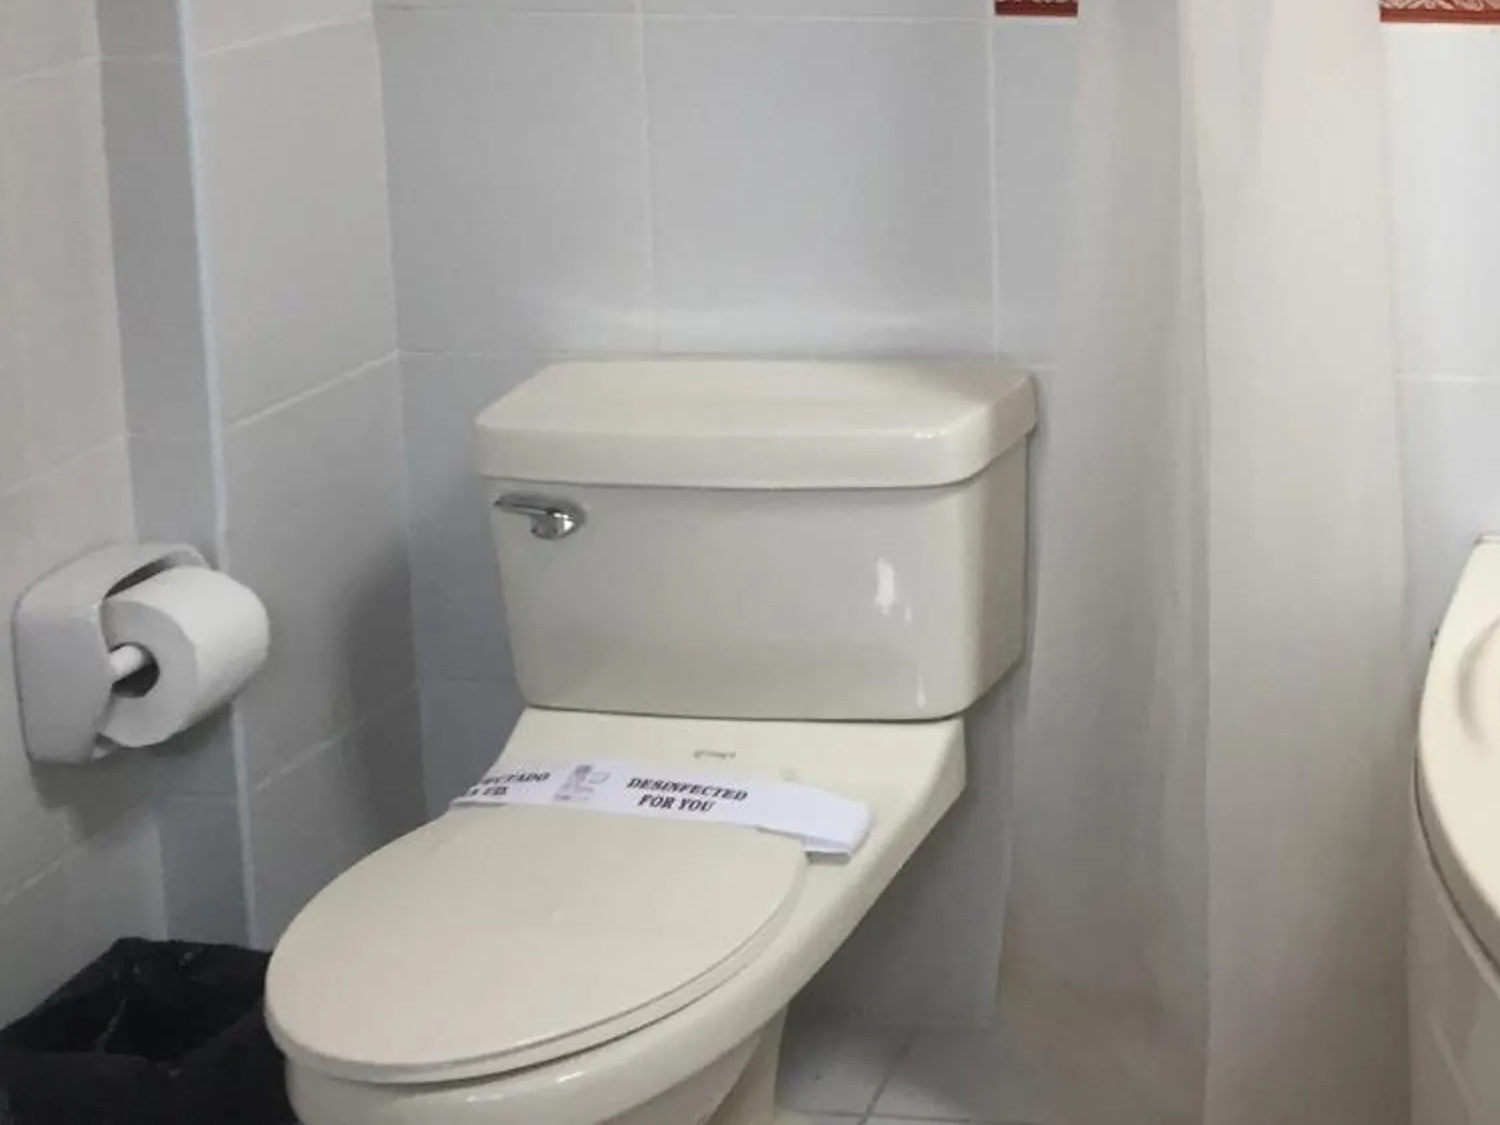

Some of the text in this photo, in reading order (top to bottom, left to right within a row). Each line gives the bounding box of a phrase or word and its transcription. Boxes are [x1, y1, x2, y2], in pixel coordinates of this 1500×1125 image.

[626, 777, 749, 802] DESINFECTED
[637, 794, 718, 813] FOR YOU
